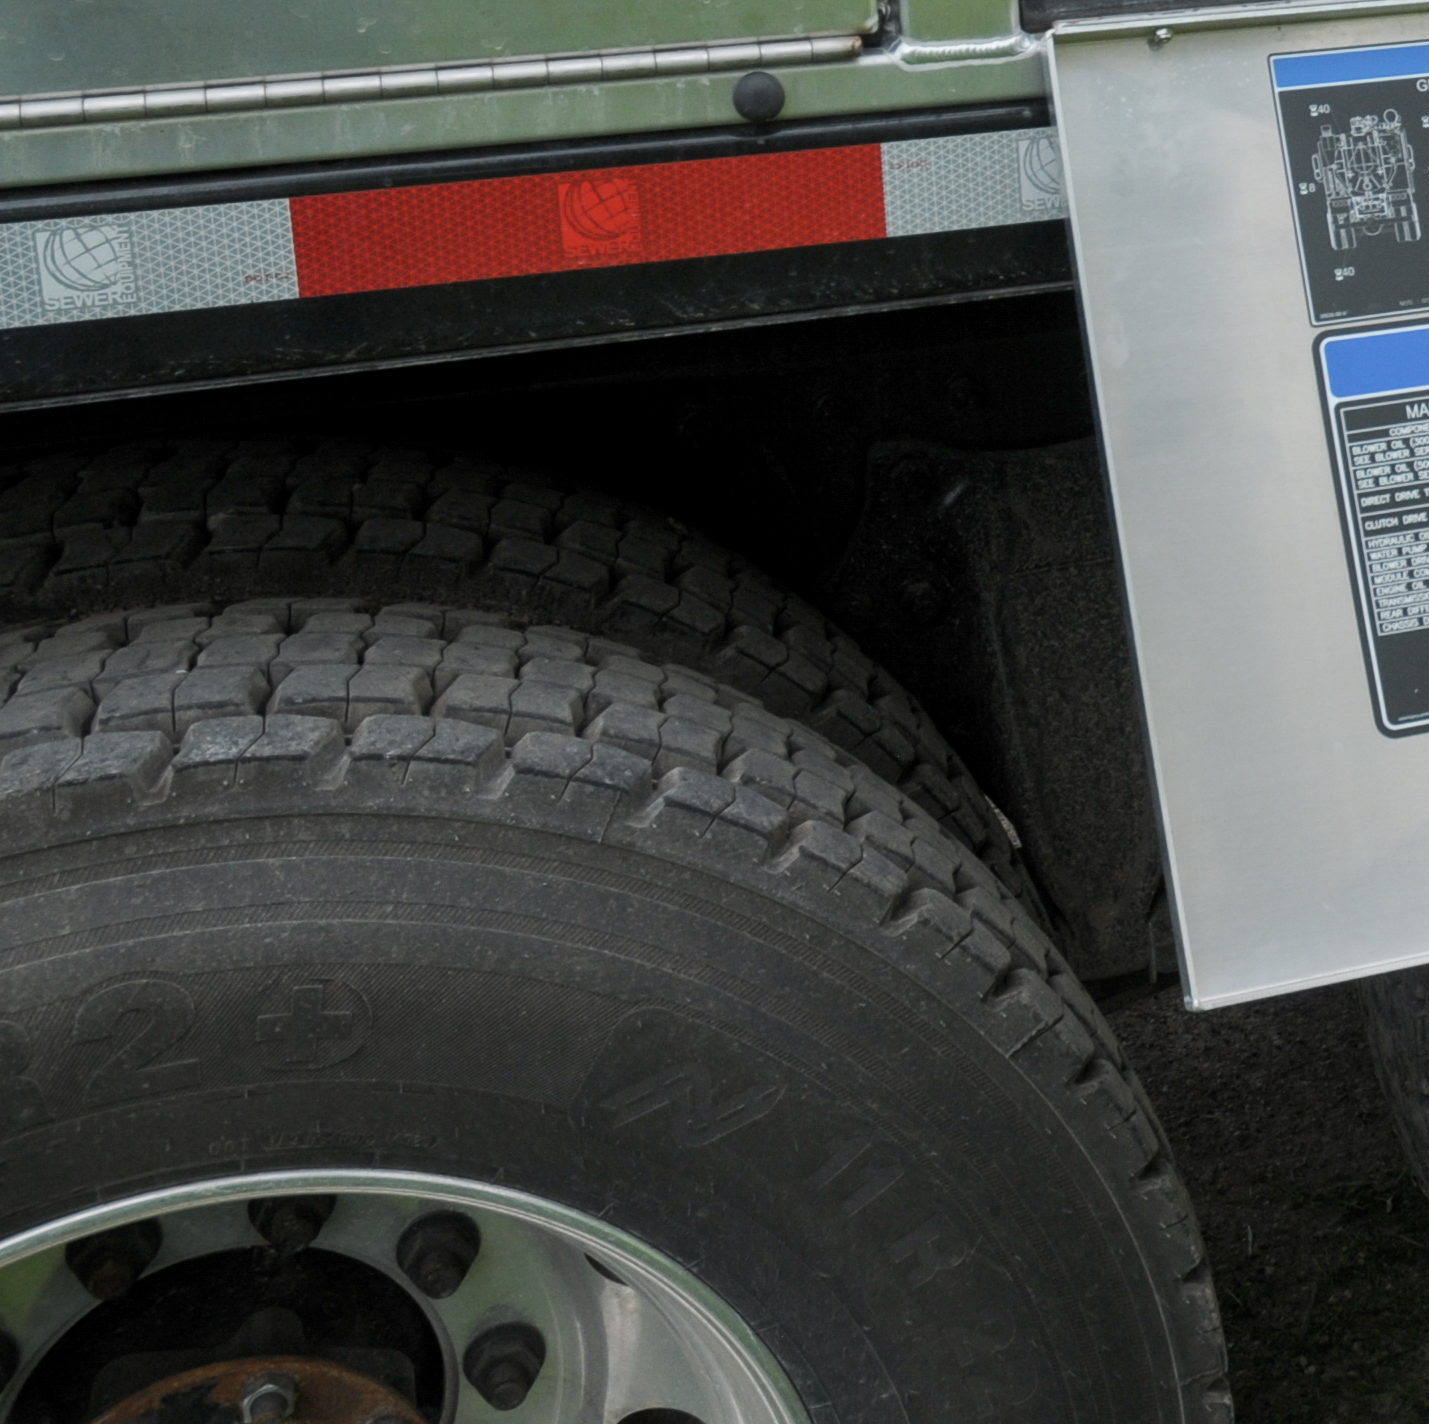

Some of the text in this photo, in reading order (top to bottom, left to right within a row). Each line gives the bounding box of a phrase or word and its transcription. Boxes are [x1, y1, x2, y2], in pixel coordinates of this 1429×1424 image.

[1318, 104, 1330, 114] 40
[1022, 198, 1062, 210] SEW
[116, 227, 137, 302] EQUIPMENT
[43, 290, 124, 311] SEWER
[1361, 495, 1391, 506] DIRECT
[1395, 489, 1421, 502] DRIVE
